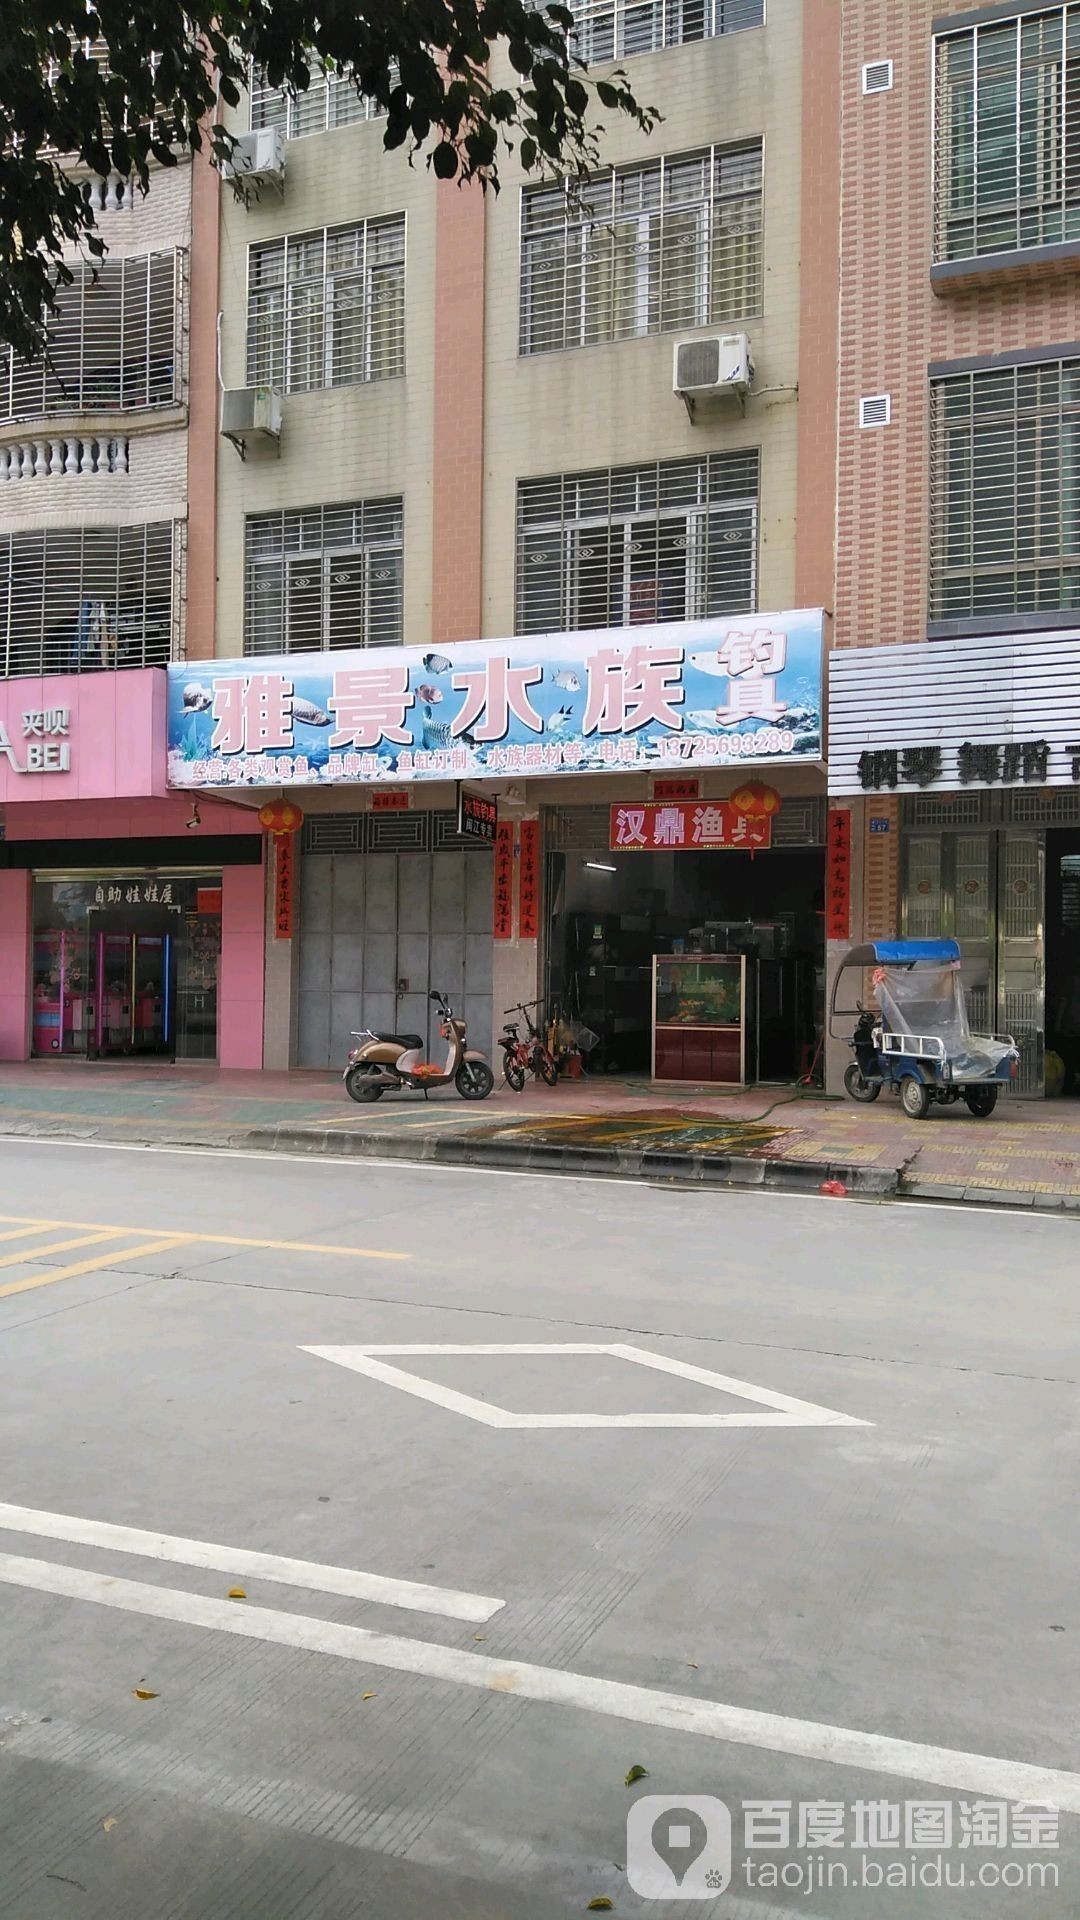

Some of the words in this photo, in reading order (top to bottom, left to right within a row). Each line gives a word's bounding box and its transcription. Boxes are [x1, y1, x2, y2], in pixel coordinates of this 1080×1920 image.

[716, 628, 788, 726] 钓具
[211, 645, 686, 755] 雅景水族
[22, 706, 69, 736] 夹呗
[27, 743, 69, 771] BEI
[95, 884, 174, 904] 自助娃娃屋
